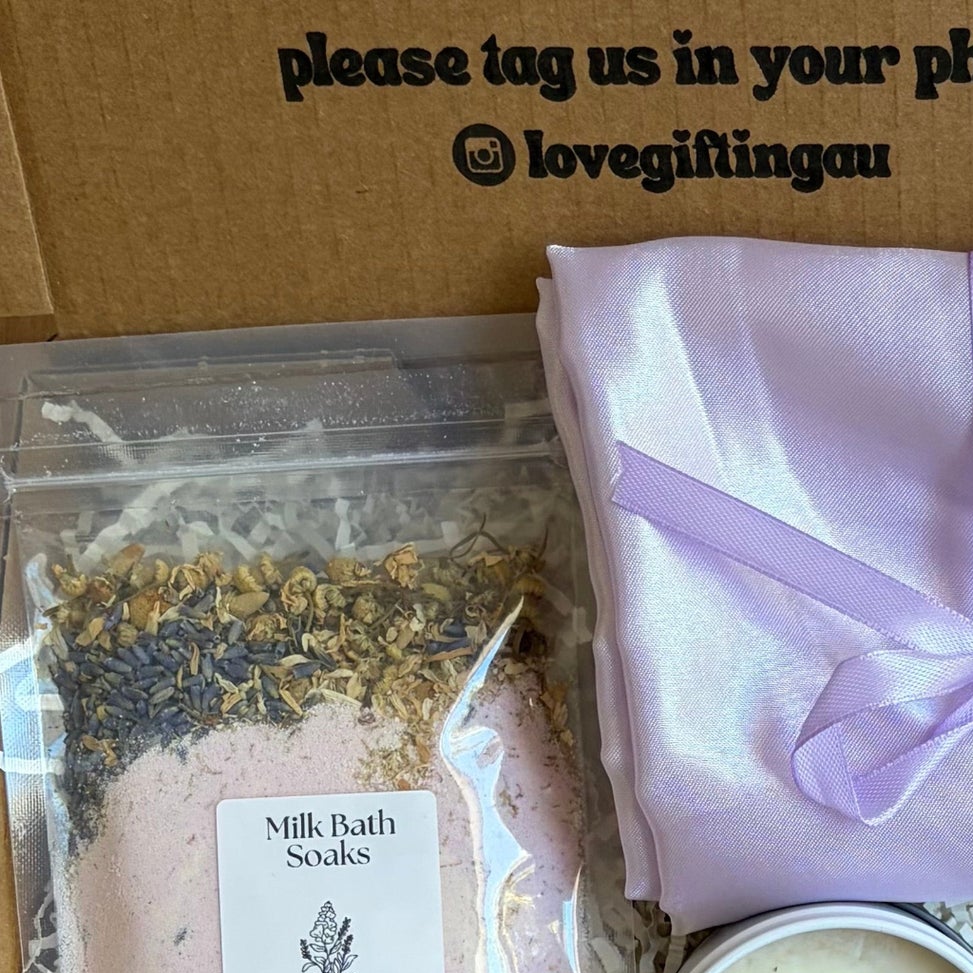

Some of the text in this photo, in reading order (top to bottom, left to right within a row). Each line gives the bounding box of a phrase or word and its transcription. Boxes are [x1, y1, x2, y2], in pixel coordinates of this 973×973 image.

[278, 31, 471, 102] please
[481, 34, 577, 102] tag
[587, 46, 662, 86] us
[673, 28, 739, 85] in
[750, 45, 900, 101] your
[523, 128, 892, 193] lovegiftingau
[266, 809, 396, 840] Milk Bath
[286, 840, 371, 867] Soaks
